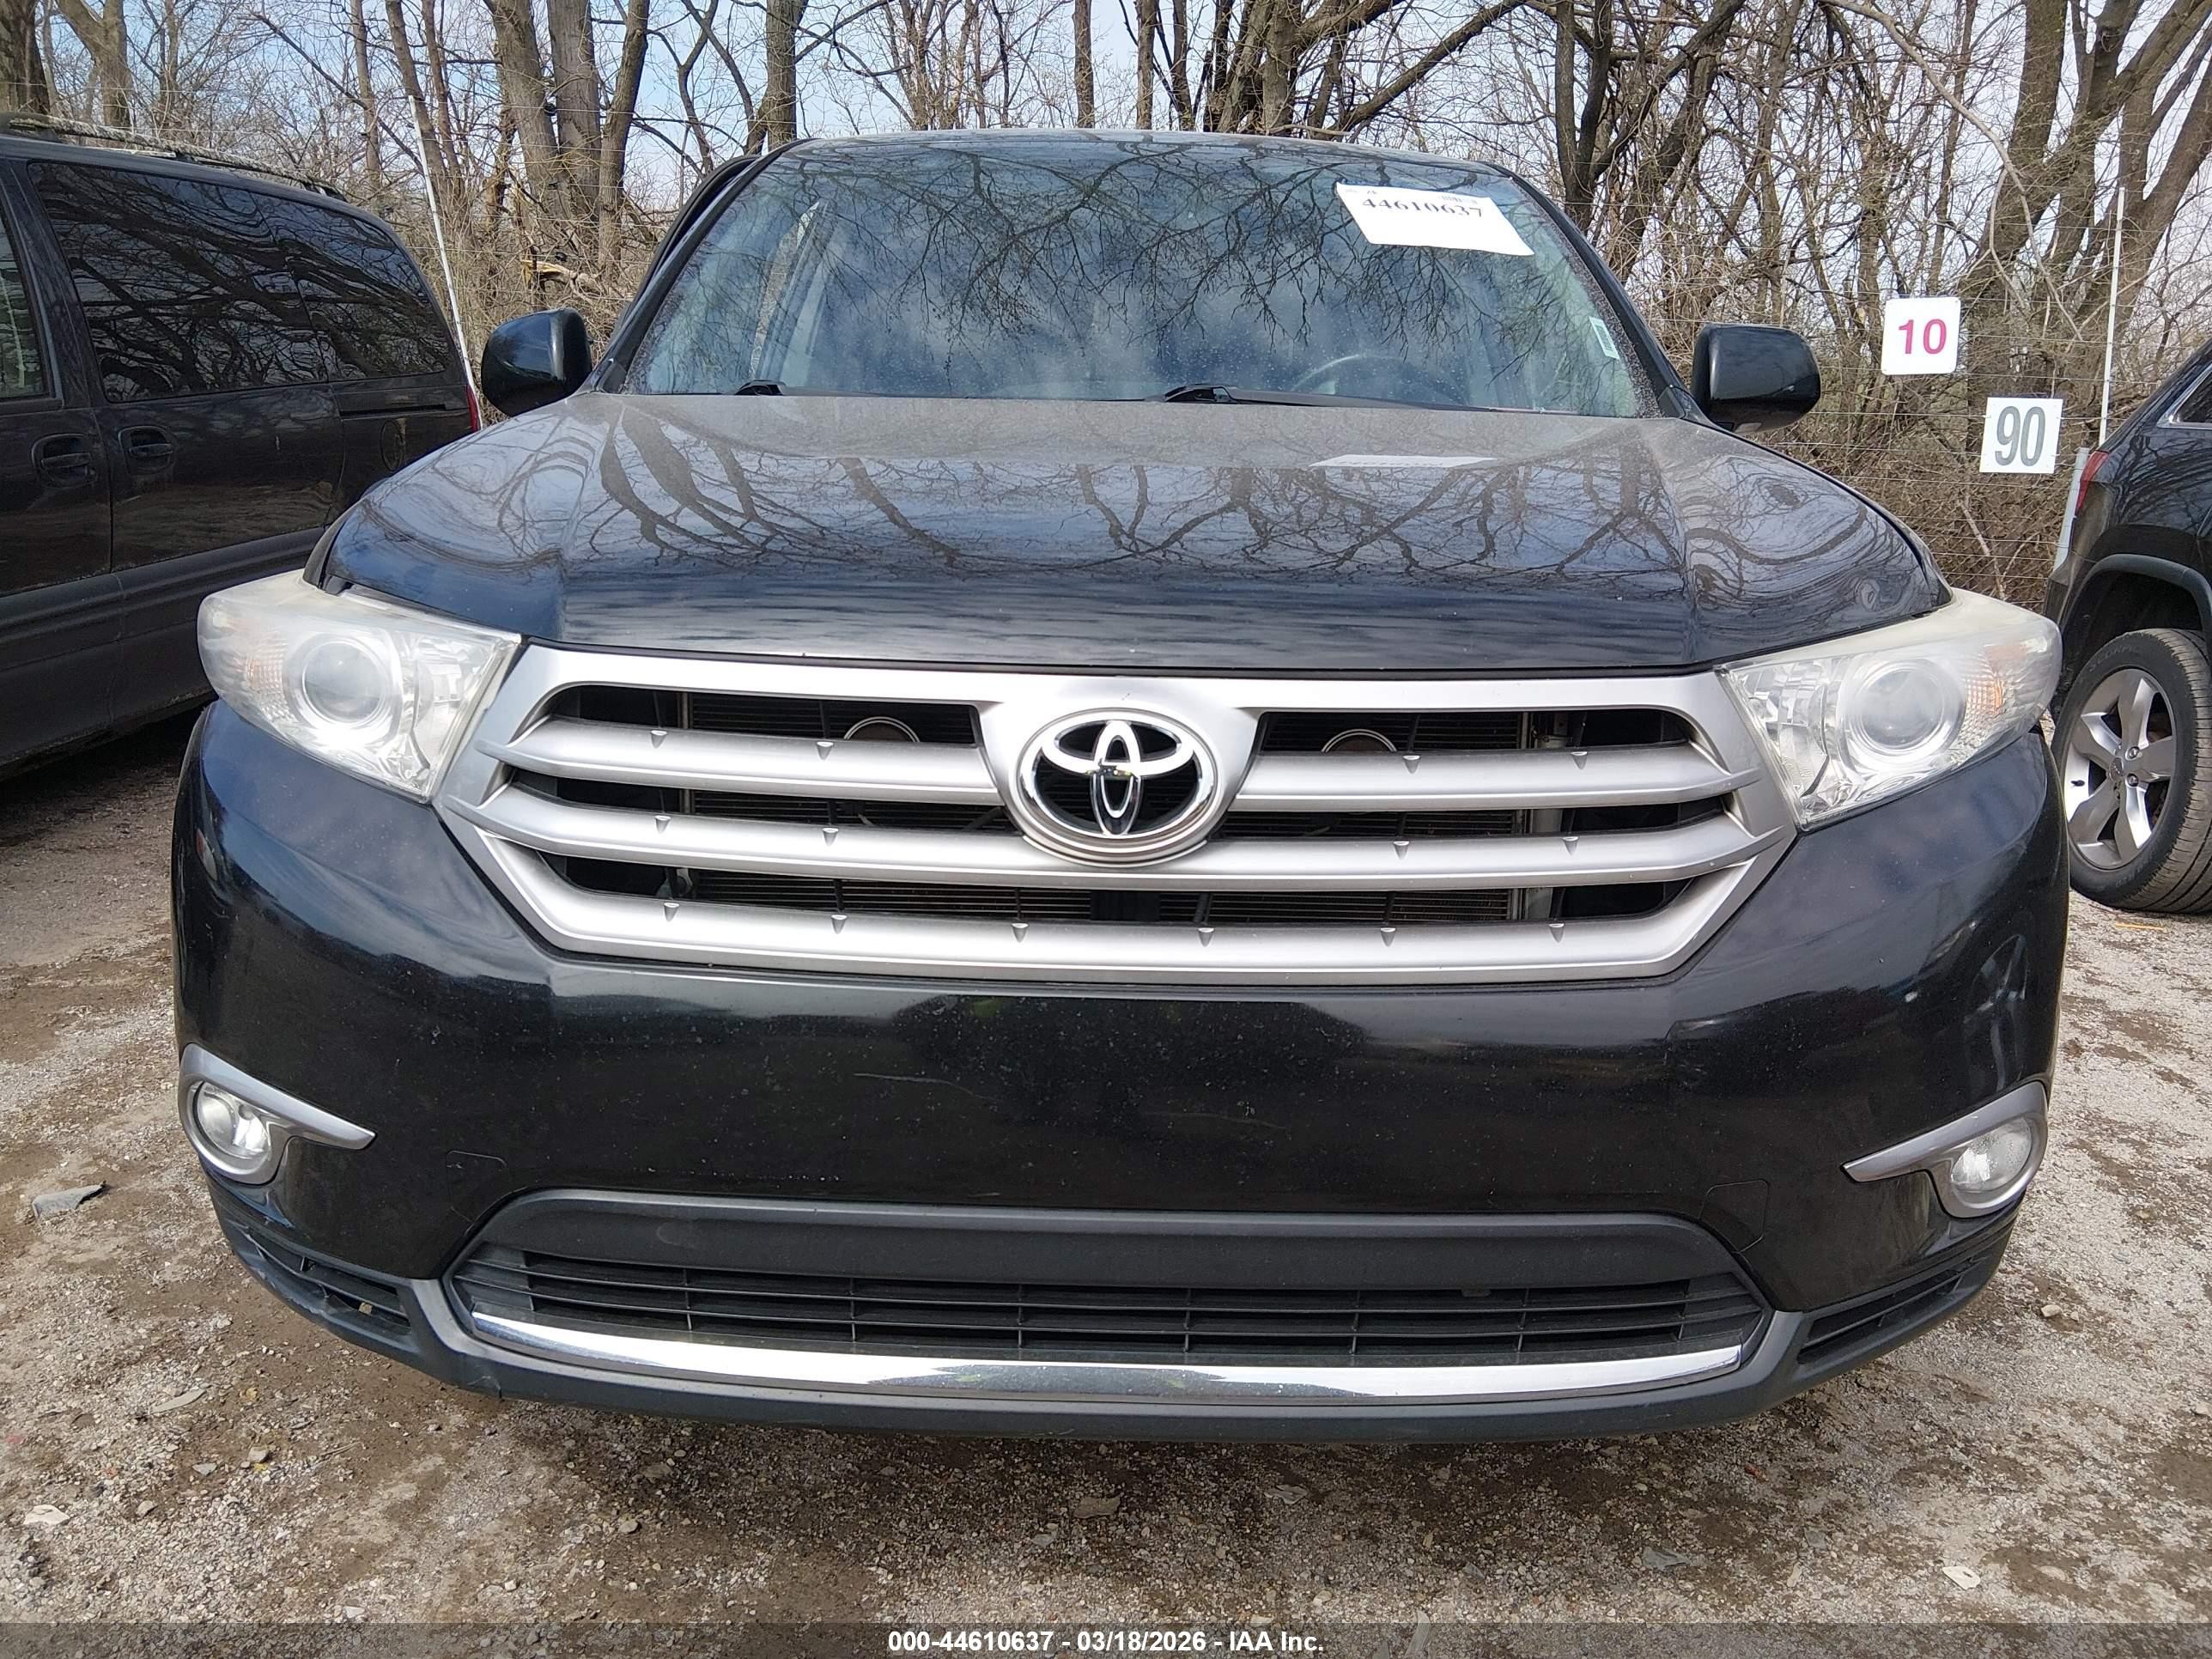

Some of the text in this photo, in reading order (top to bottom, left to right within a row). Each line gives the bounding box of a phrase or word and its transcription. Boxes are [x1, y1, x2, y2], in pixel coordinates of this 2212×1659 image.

[1363, 198, 1482, 217] 44610637
[1899, 319, 1948, 355] 10
[1995, 405, 2046, 466] 90
